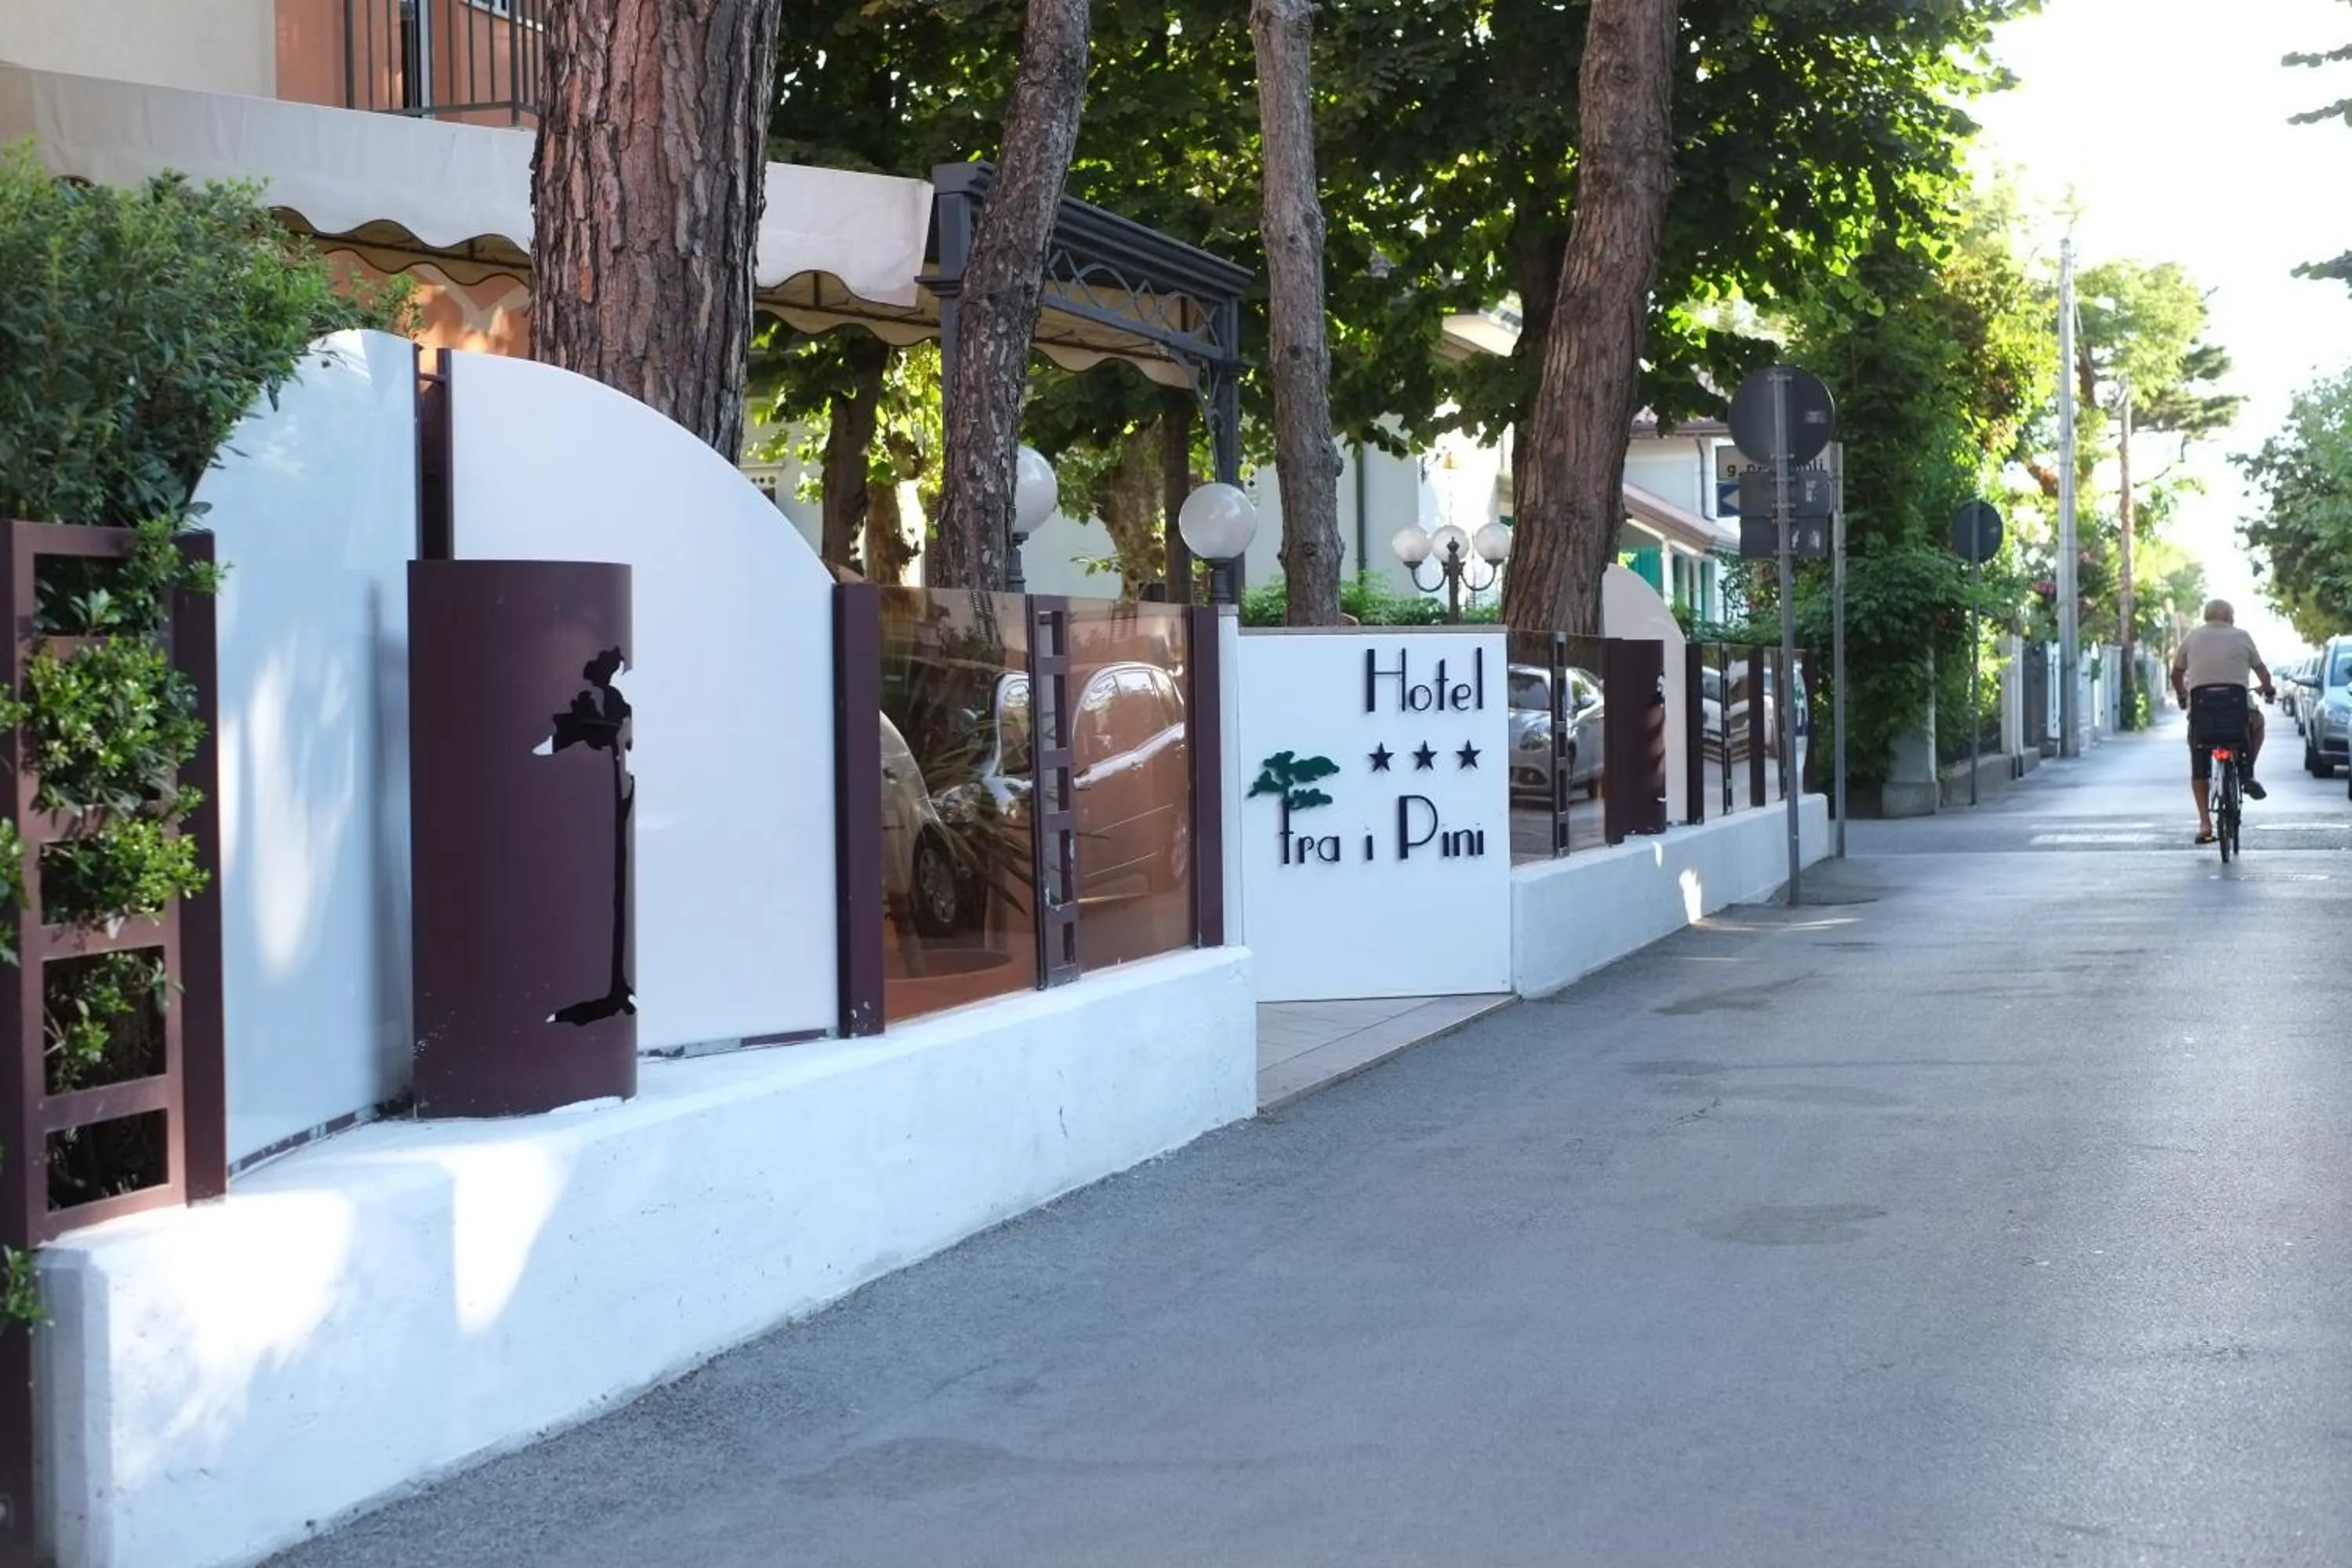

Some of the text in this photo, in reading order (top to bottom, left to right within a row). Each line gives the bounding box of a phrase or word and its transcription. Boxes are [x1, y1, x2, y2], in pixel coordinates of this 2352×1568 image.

[1365, 647, 1484, 713] Hotel
[1365, 826, 1374, 862] i
[1397, 794, 1485, 861] Pini
